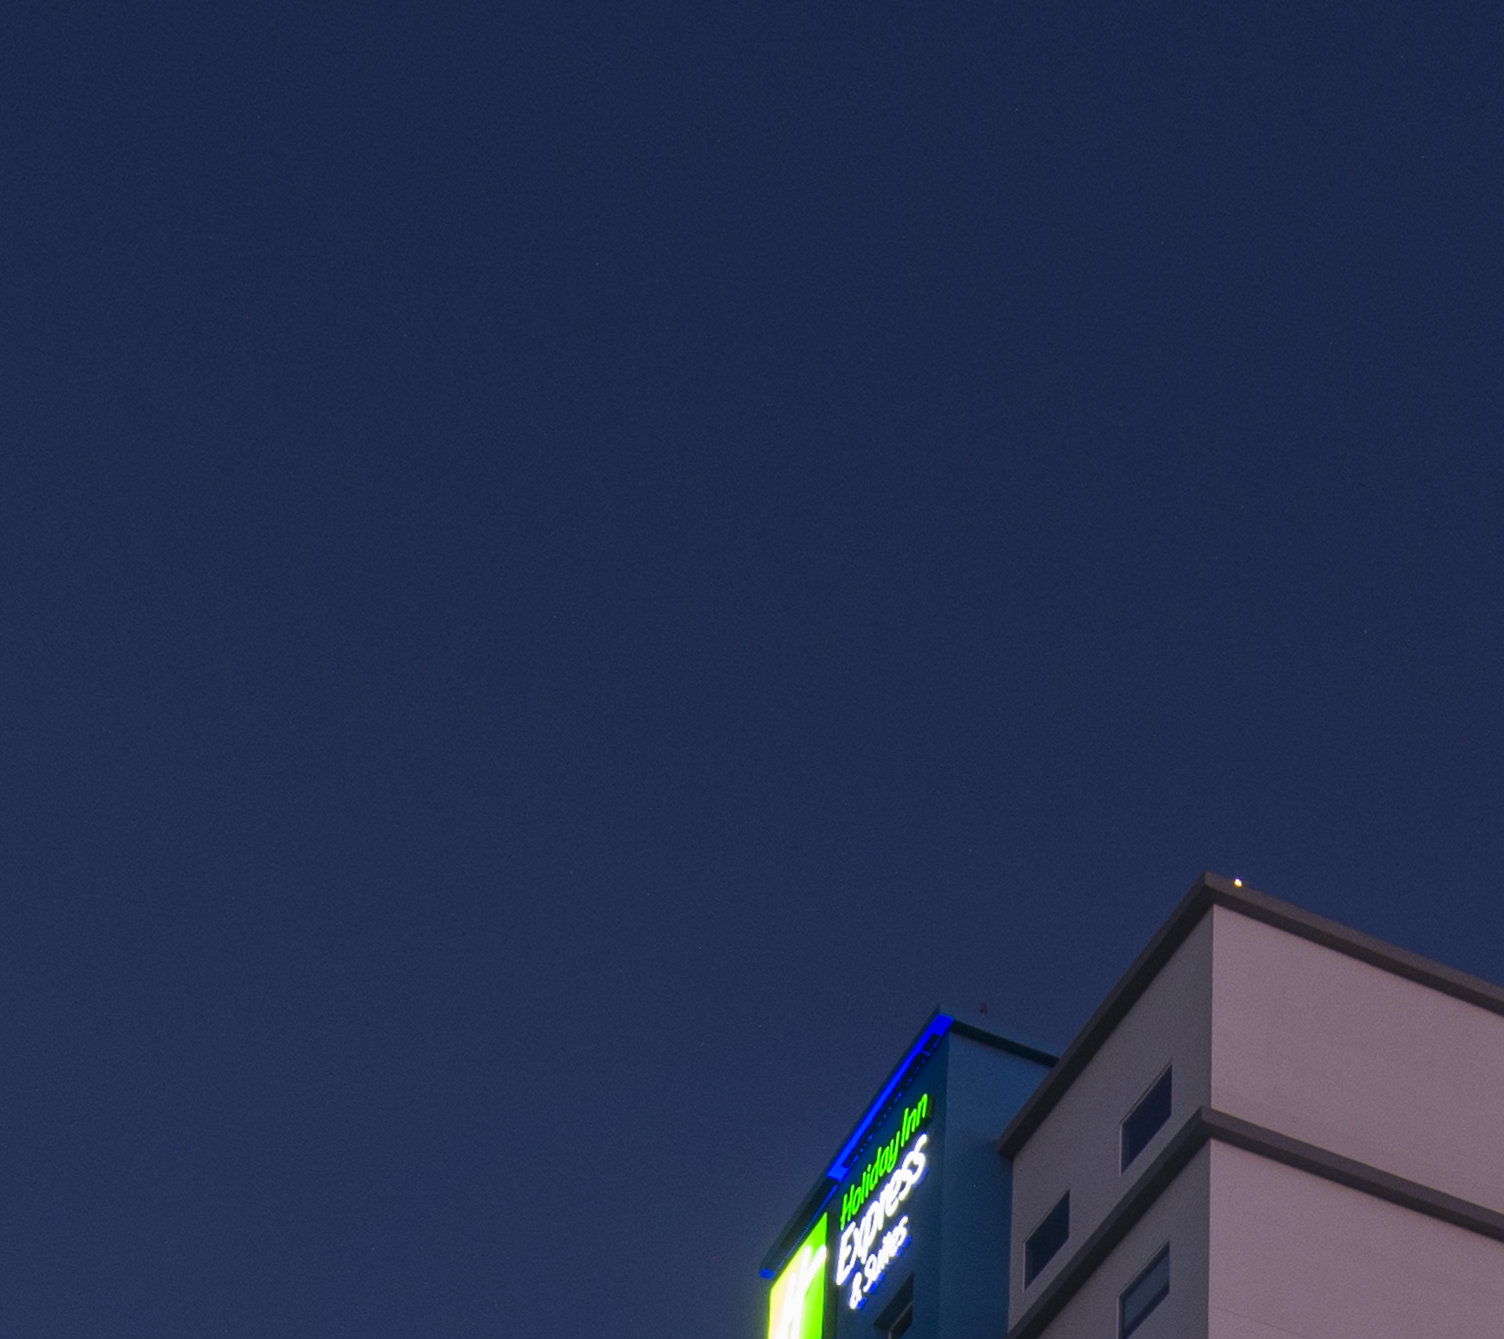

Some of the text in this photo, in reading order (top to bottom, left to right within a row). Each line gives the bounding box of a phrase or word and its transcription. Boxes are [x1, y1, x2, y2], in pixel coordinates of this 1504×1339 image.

[836, 1133, 928, 1285] Express
[839, 1093, 929, 1231] Holiday Inn
[862, 1215, 909, 1293] Suites
